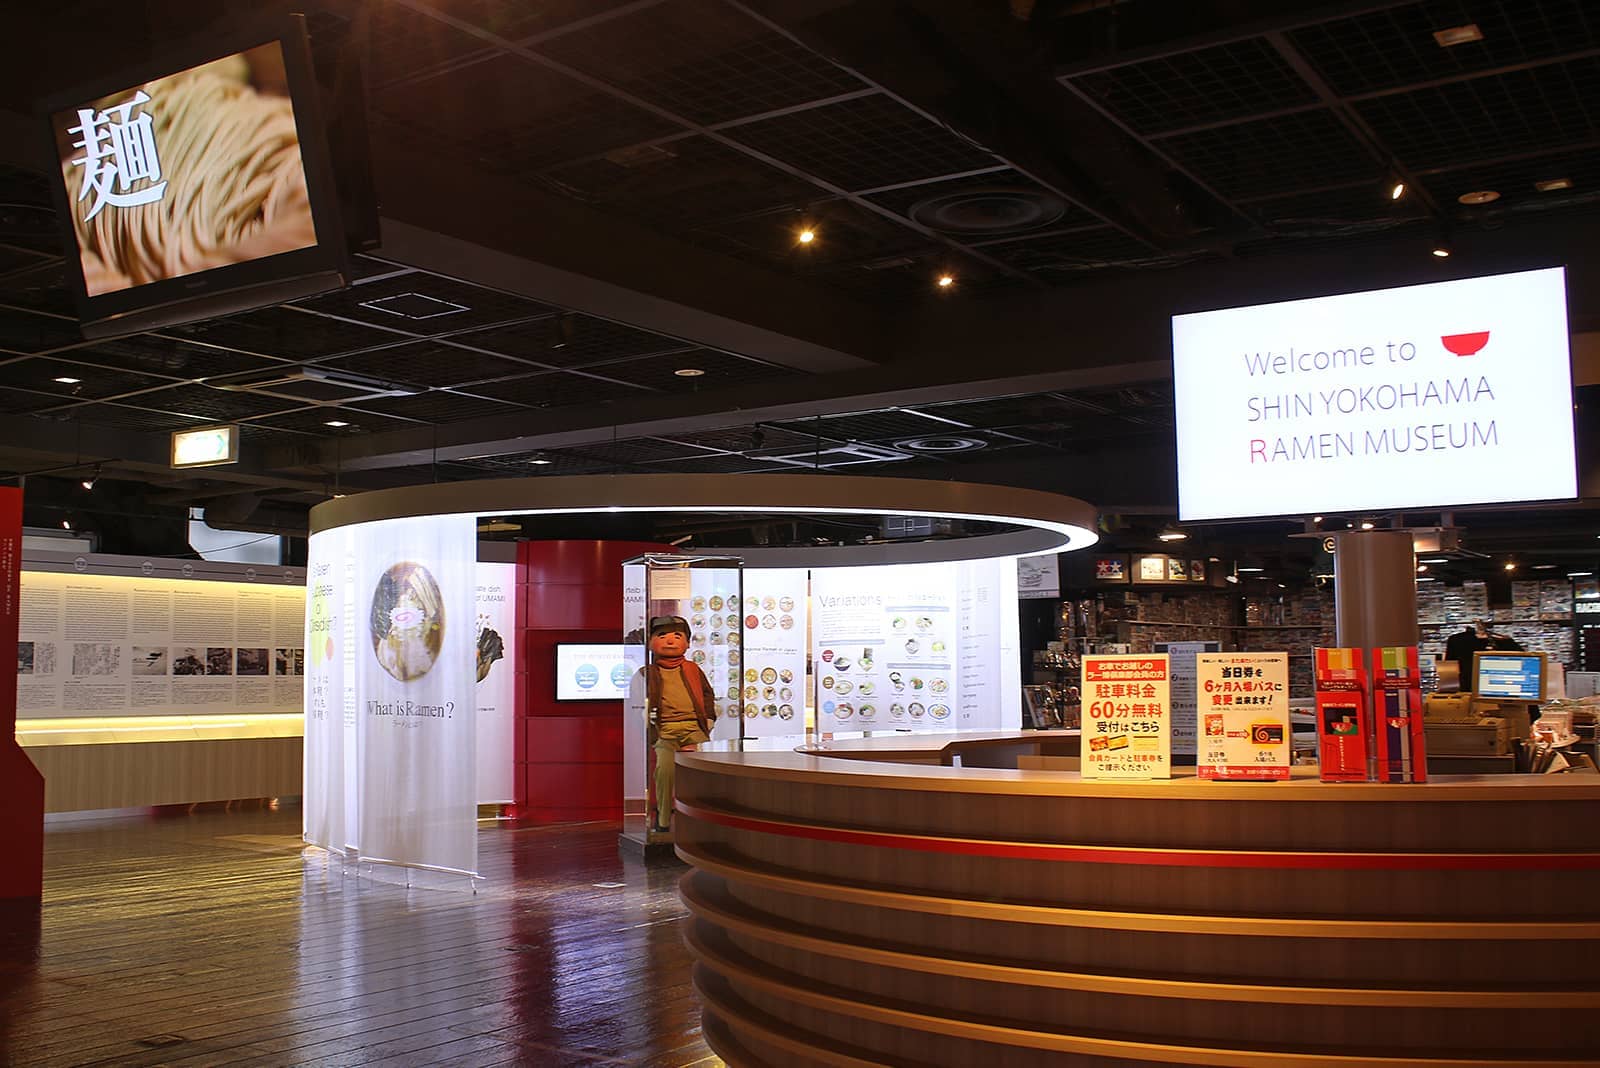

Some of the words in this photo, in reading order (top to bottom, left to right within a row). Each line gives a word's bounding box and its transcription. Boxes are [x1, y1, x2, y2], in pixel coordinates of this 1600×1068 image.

[67, 90, 169, 222] 麺
[1245, 343, 1375, 376] Welcome
[1386, 340, 1416, 363] to
[1247, 392, 1312, 421] SHIN
[1319, 375, 1495, 414] YOKOHAMA
[1249, 431, 1354, 464] RAMEN
[1365, 420, 1498, 454] MUSEUM
[818, 593, 882, 609] Variations
[1222, 667, 1263, 678] 当日券を
[1096, 683, 1156, 698] 駐車料金
[1212, 694, 1233, 705] 変更
[396, 700, 404, 716] is
[406, 700, 455, 719] Ramen?
[1089, 701, 1163, 718] 60分無料
[1096, 721, 1160, 733] 受付はこちら
